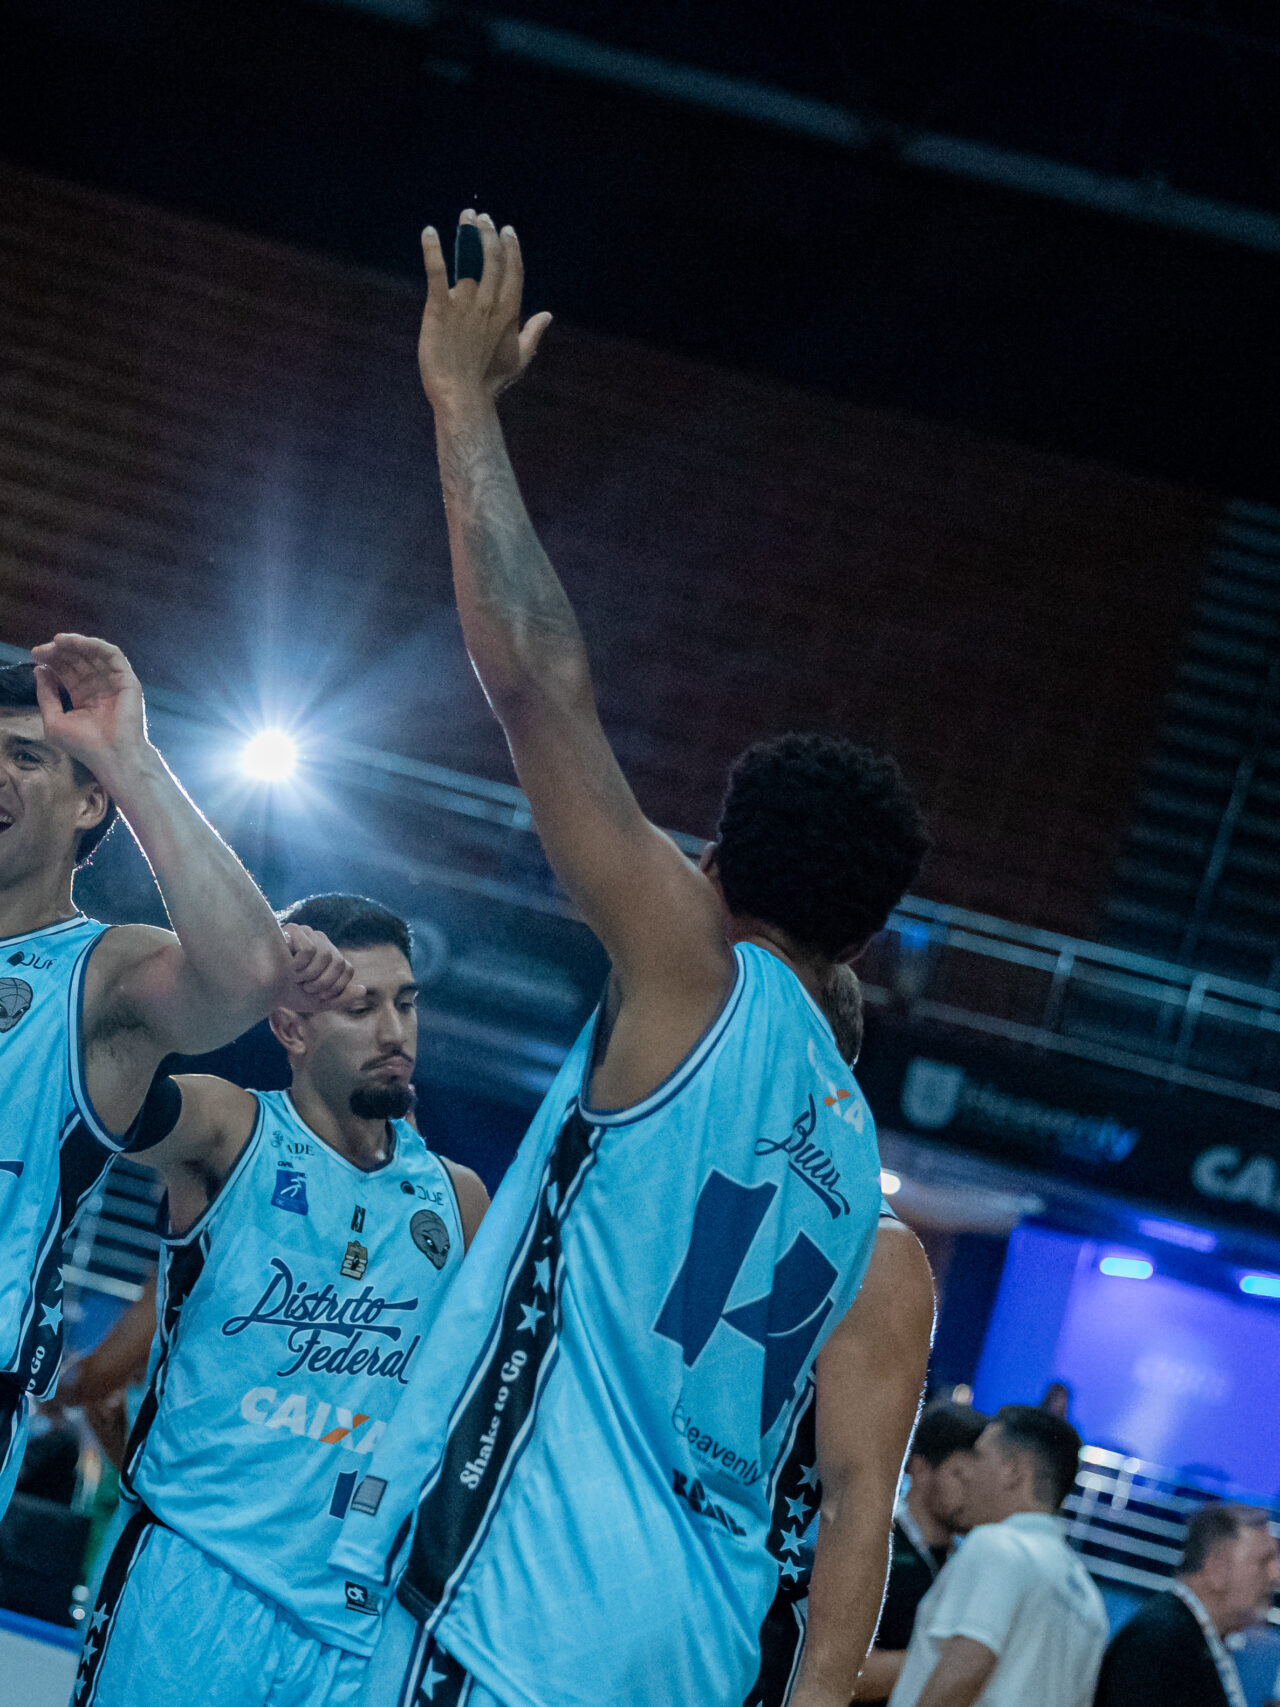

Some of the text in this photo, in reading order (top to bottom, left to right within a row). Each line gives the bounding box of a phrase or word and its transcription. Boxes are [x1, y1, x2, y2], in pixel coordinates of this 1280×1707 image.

[222, 1257, 418, 1341] Distrito
[276, 1326, 421, 1384] Federal
[460, 1350, 528, 1489] Shake to Go
